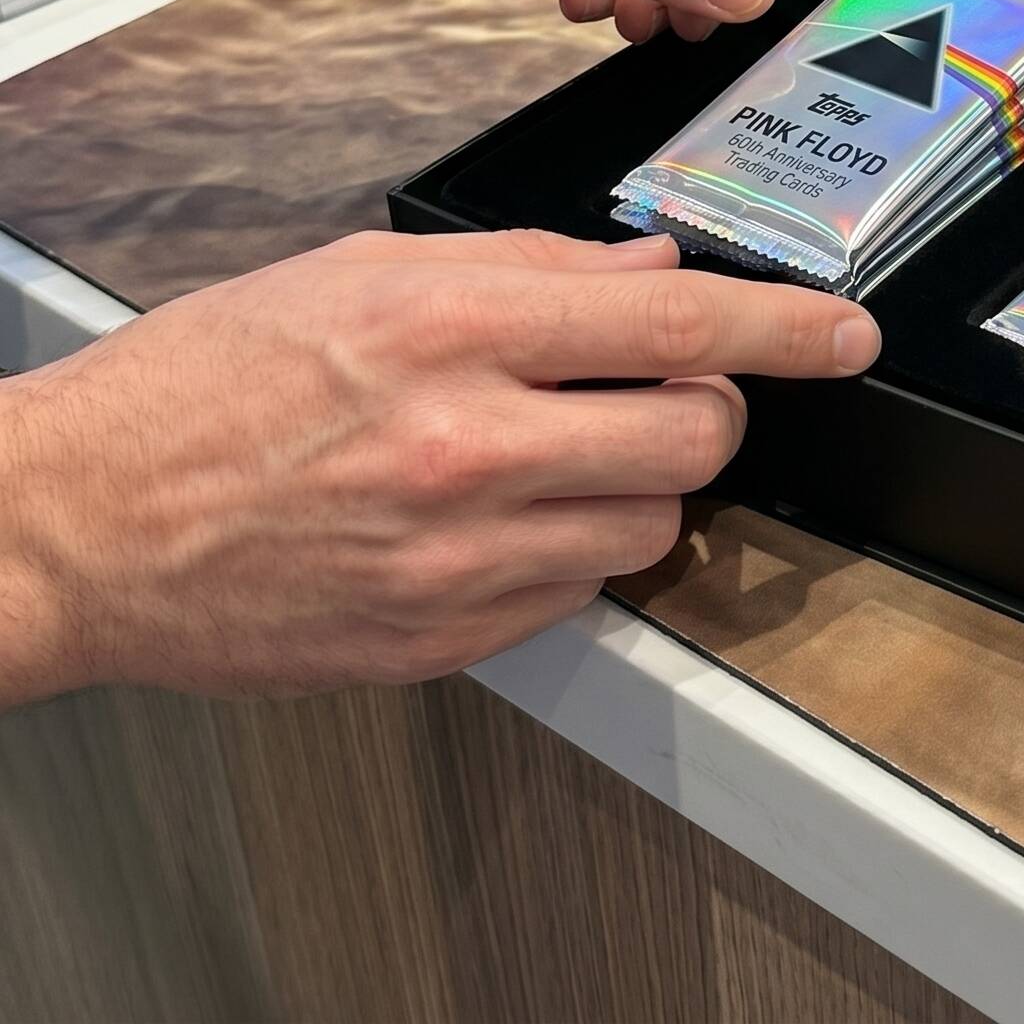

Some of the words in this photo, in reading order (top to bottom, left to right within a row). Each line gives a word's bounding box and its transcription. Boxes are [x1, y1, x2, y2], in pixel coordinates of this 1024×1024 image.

[807, 92, 872, 126] Topps
[728, 133, 764, 155] 60th
[762, 147, 853, 190] Anniversary
[729, 106, 802, 144] PINK
[796, 130, 887, 176] FLOYD
[724, 151, 777, 184] Trading
[780, 174, 824, 198] Cards
